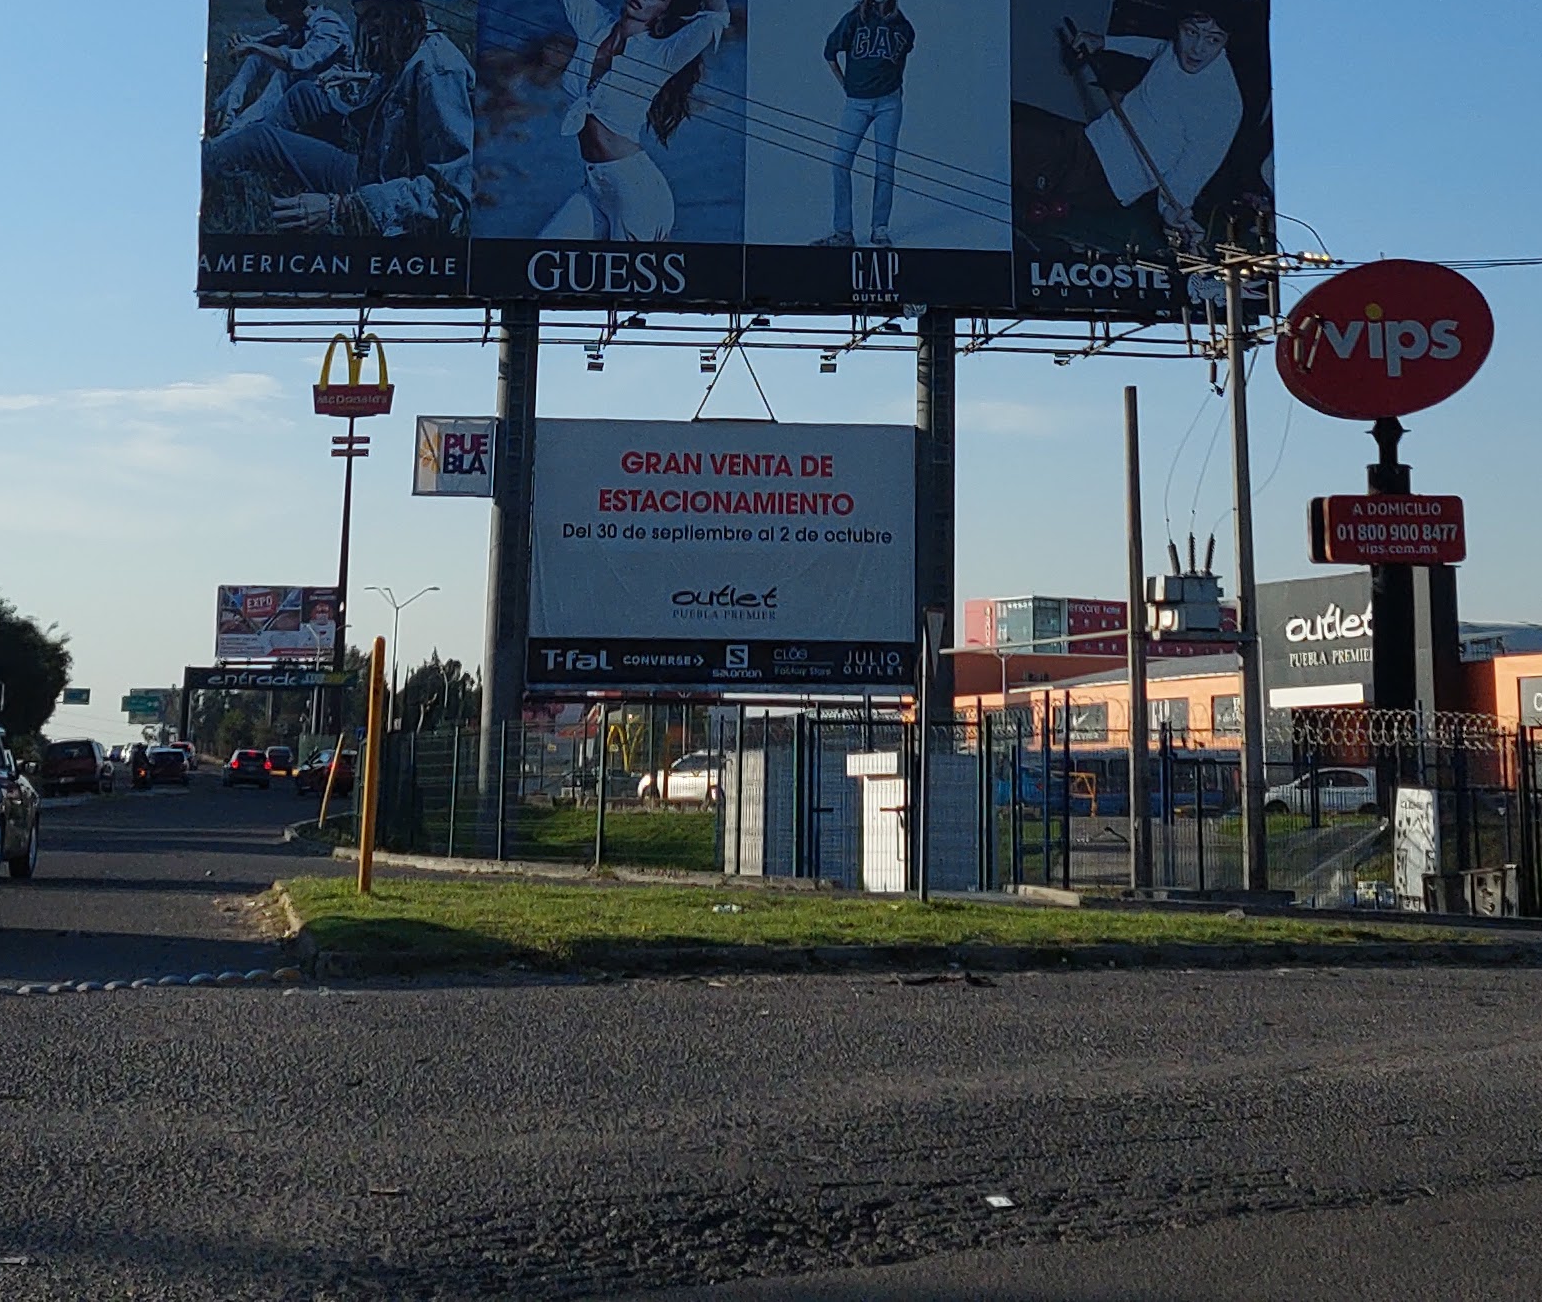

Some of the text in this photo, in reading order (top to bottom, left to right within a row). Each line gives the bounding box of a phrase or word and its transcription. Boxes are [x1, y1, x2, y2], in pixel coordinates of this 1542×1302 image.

[197, 253, 457, 276] AMERICAN EAGLE
[527, 249, 687, 295] GUESS
[851, 250, 900, 291] GAP
[1030, 261, 1172, 289] LACOSTE
[851, 293, 900, 303] OUTLET
[1324, 302, 1462, 377] vips
[444, 433, 489, 455] PUE
[442, 452, 487, 475] BLA
[620, 450, 833, 478] GRAN VENTA DE
[597, 488, 855, 517] ESTACIONAMIENTO
[1353, 502, 1442, 517] A DOMICILIO
[562, 522, 893, 545] Del 30 de septiembre al 2 de octubre
[1337, 523, 1458, 541] 01 800 900 8477
[1359, 543, 1438, 555] vips.com.mx
[246, 595, 274, 609] EXPO
[671, 584, 778, 609] outlet
[672, 609, 777, 620] PUEBLA PREMIER
[1285, 599, 1373, 642] outlet
[622, 654, 692, 667] CONVERSE
[844, 649, 900, 667] JULIO
[1289, 650, 1327, 667] PUEBLA
[842, 665, 906, 676] OUTLET
